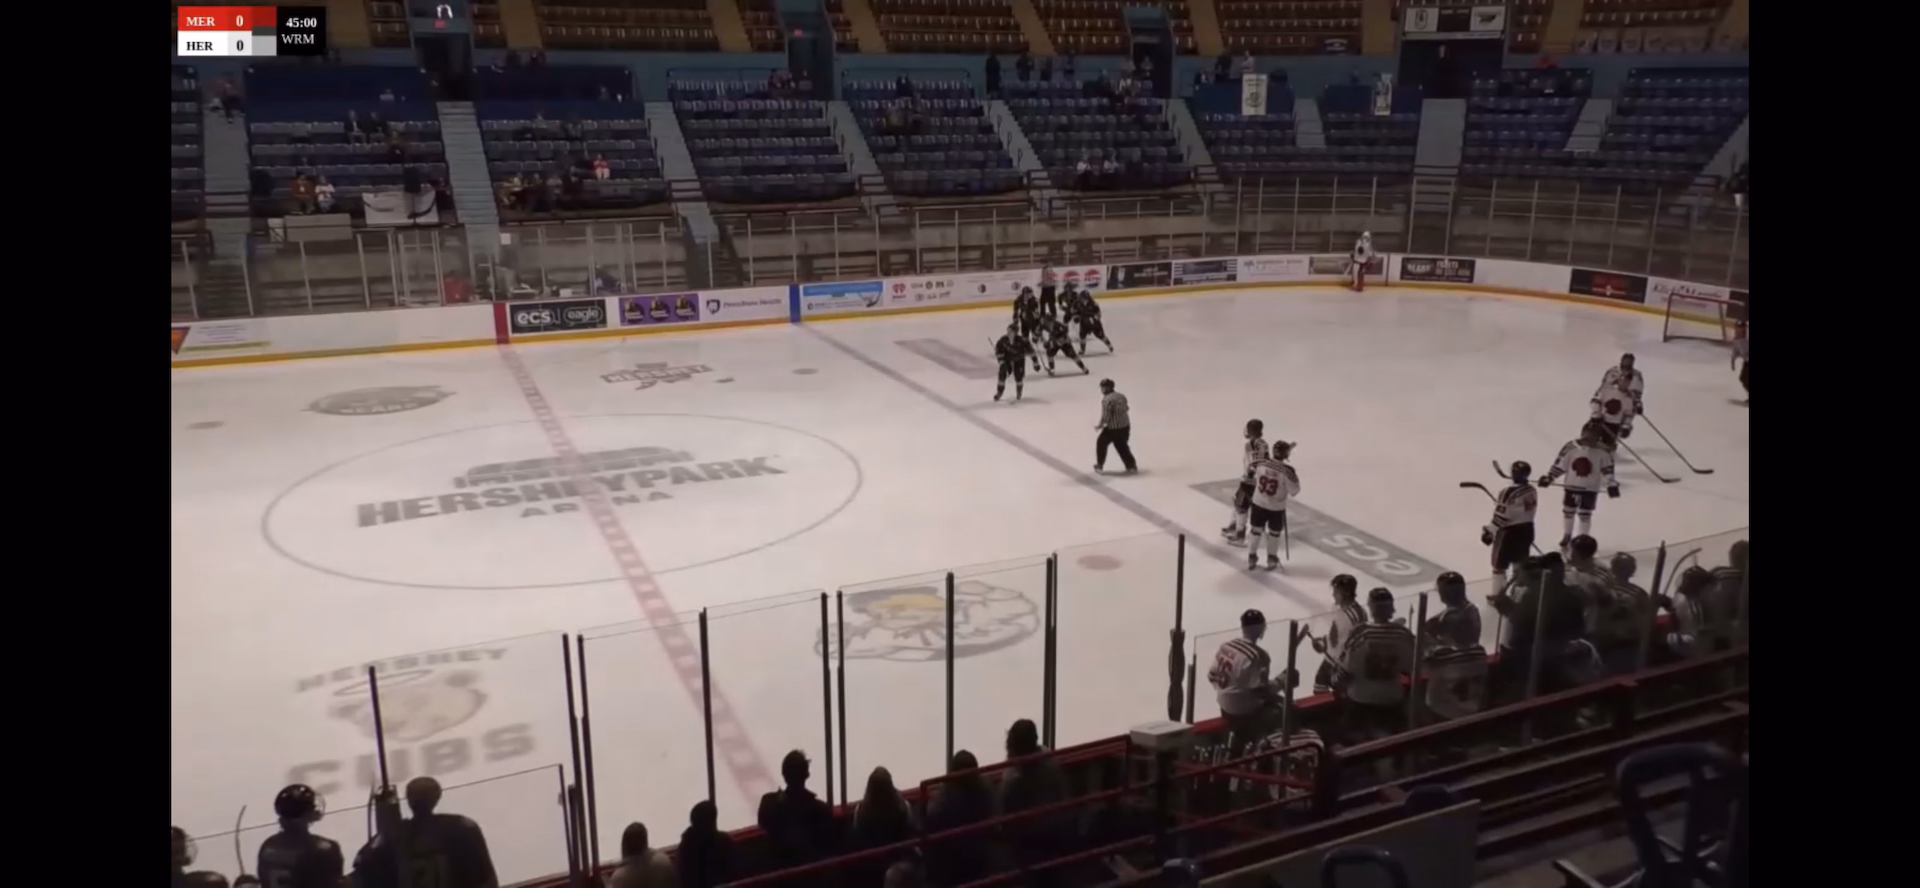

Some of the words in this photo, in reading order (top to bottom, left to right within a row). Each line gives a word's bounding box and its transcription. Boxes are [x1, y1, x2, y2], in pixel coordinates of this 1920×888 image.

[517, 310, 551, 325] ecs
[567, 308, 599, 321] eagle
[1257, 475, 1278, 496] 93
[520, 491, 675, 518] ARNA
